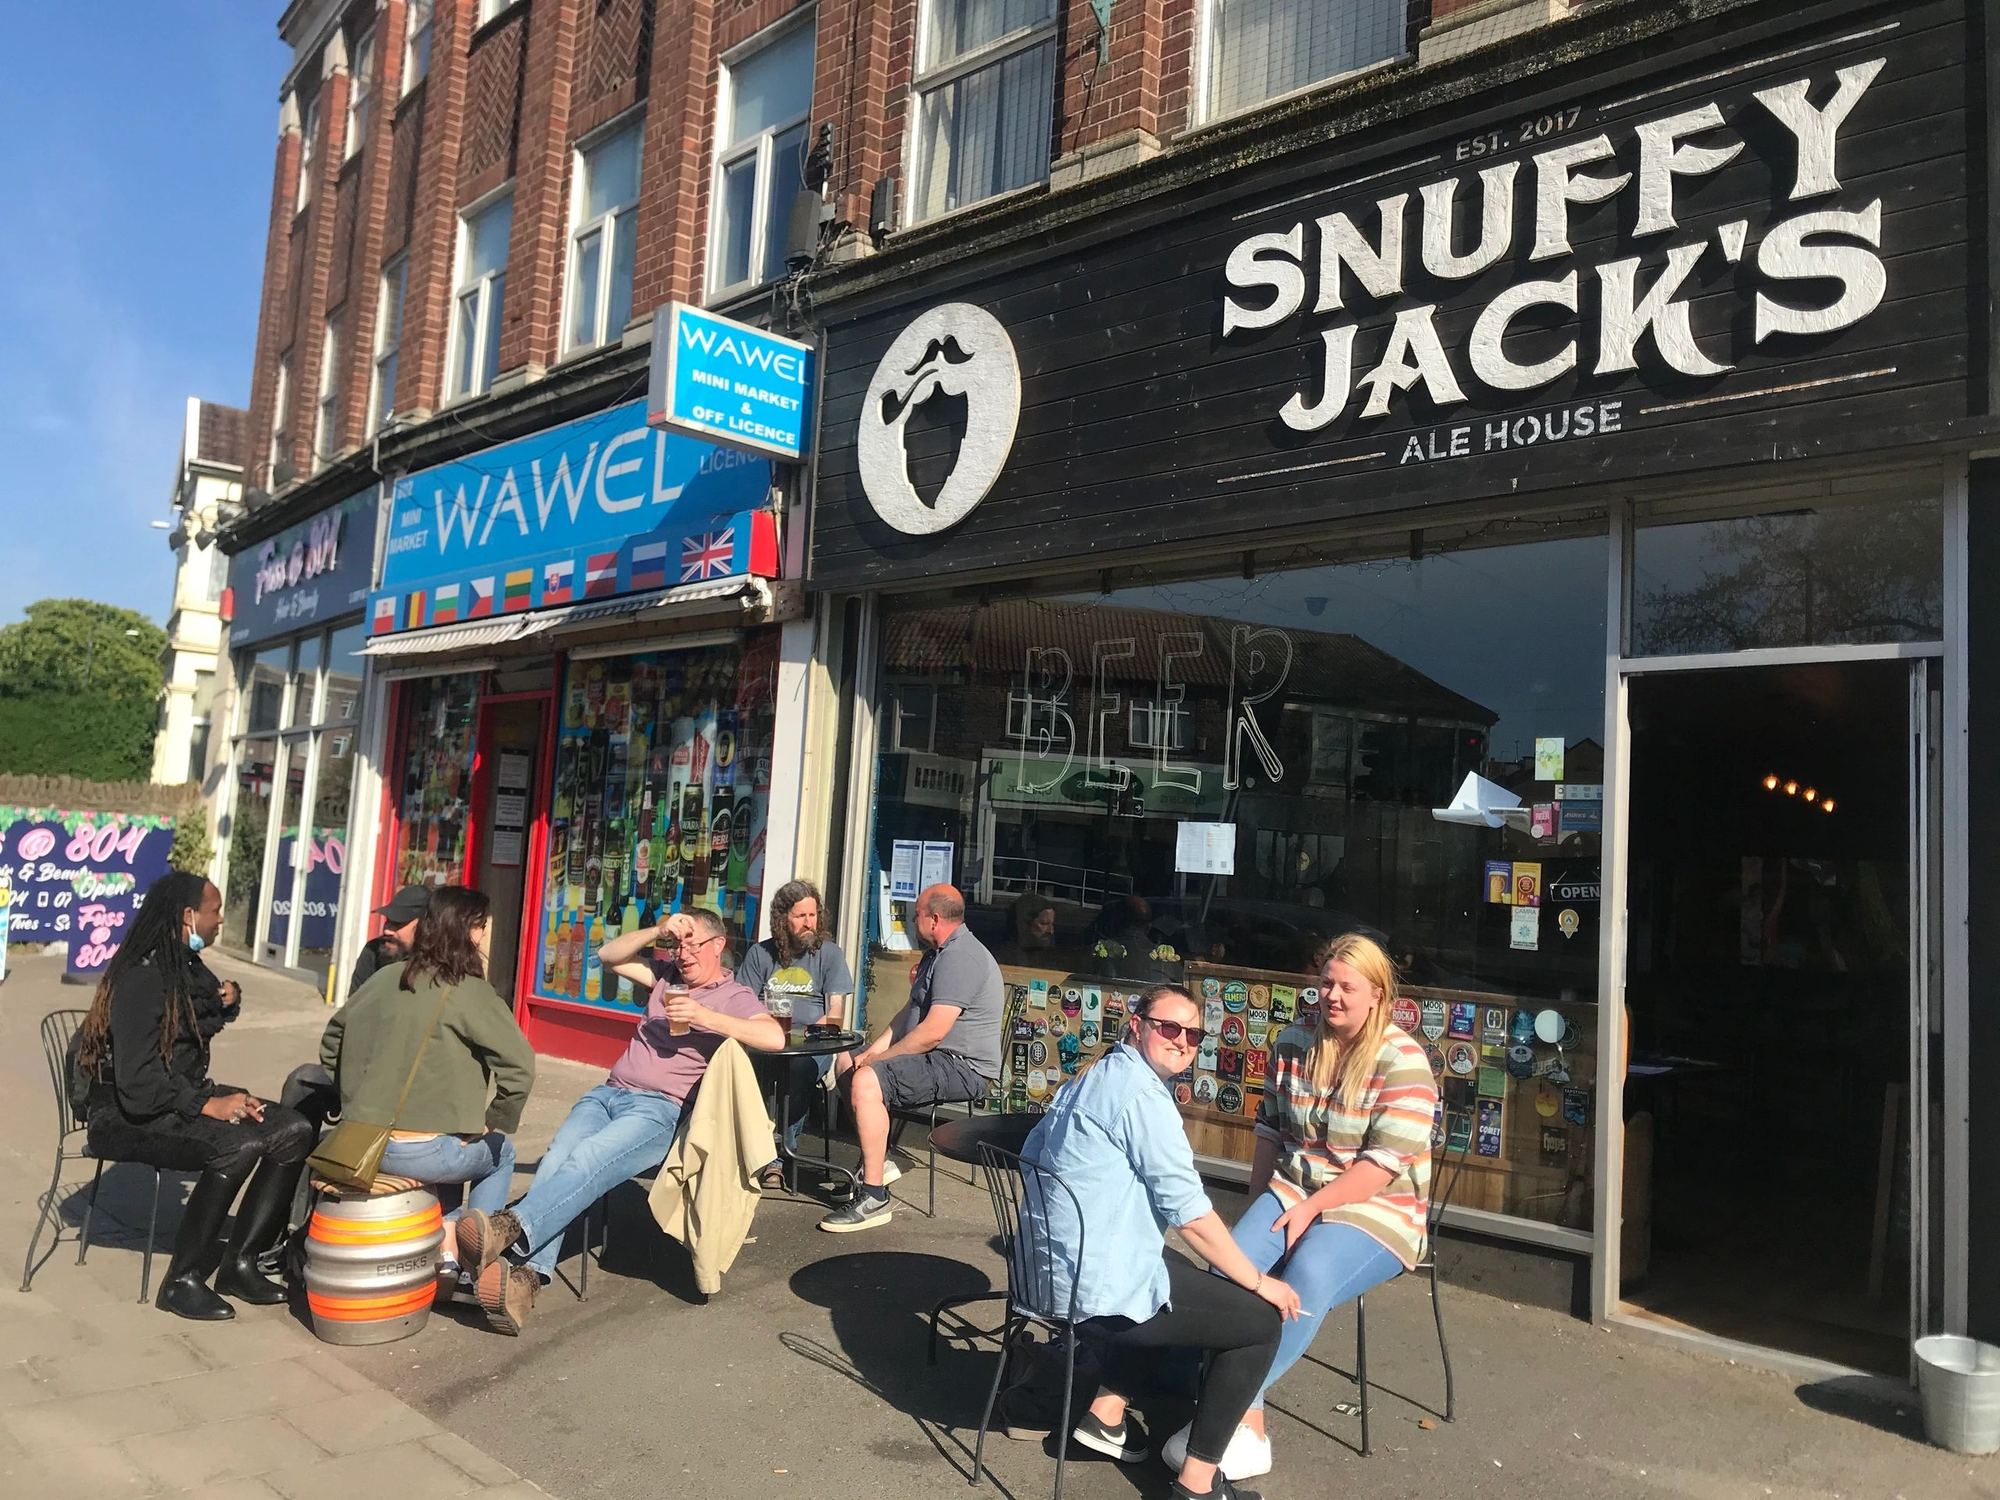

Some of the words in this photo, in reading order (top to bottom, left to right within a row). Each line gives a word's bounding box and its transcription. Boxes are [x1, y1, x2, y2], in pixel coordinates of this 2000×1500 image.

[1456, 131, 1509, 161] EST.
[1518, 106, 1583, 144] 2017
[1222, 57, 1887, 337] SNUFFY
[1278, 198, 1888, 432] JACK'S
[681, 320, 810, 385] WAWEL
[692, 369, 730, 392] MINI
[734, 382, 800, 412] MARKET
[741, 402, 753, 416] &
[692, 406, 725, 425] OFF
[729, 416, 796, 446] LICENCE
[1400, 426, 1471, 465] ALE
[1484, 400, 1623, 452] HOUSE
[700, 447, 760, 476] LICENC
[434, 428, 684, 556] WAWEL
[402, 508, 422, 528] MINI
[389, 530, 429, 554] MARKET
[1017, 624, 1294, 795] BEER
[18, 828, 56, 861] @
[65, 823, 149, 865] 804
[18, 862, 35, 883] &
[79, 874, 127, 902] Open
[1561, 885, 1600, 899] OPEN
[78, 904, 126, 931] Fuss
[768, 977, 814, 993] Saltrock
[1249, 1011, 1267, 1021] MOOR
[1423, 1001, 1444, 1013] MOOR
[1479, 1125, 1501, 1136] COMET
[377, 1255, 428, 1277] ECASKS
